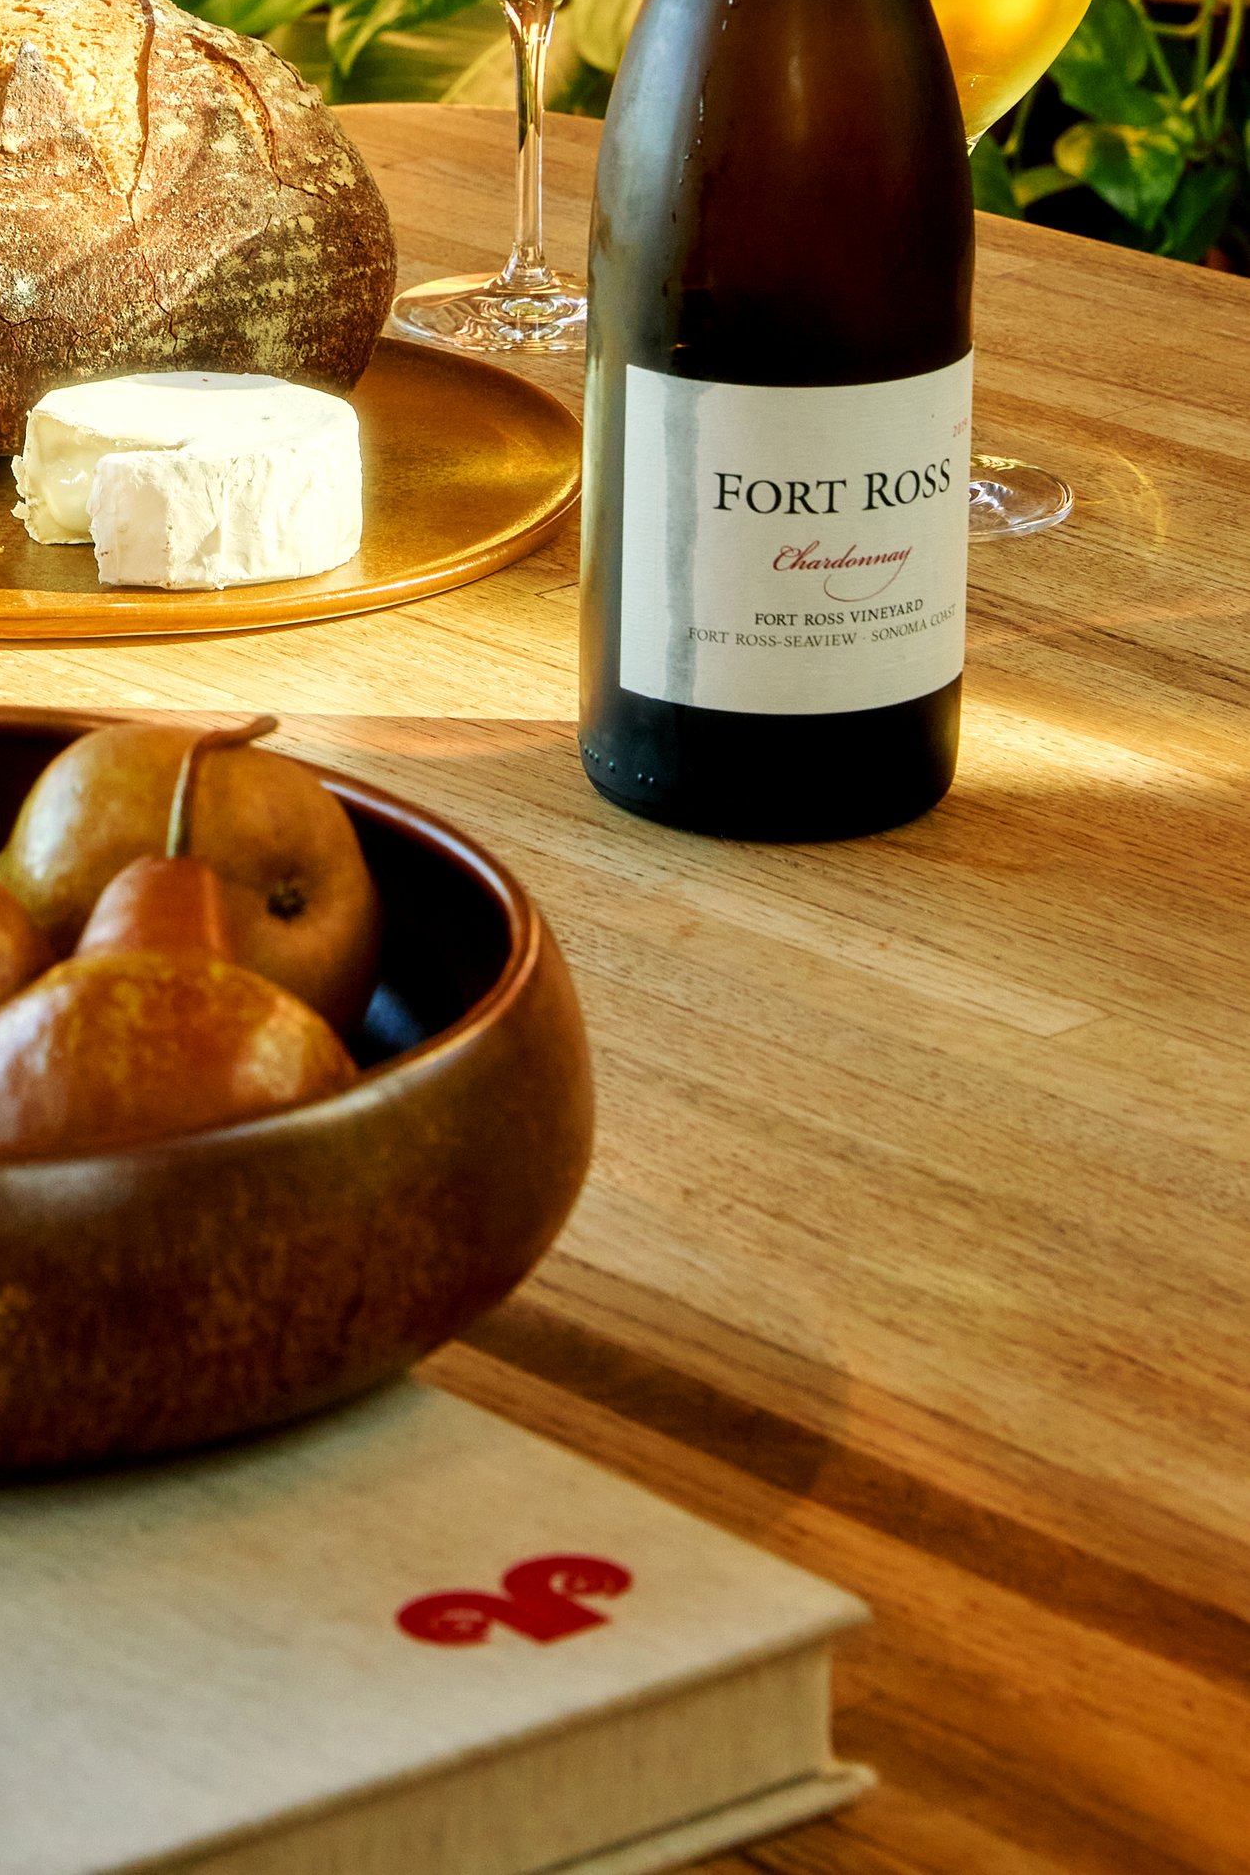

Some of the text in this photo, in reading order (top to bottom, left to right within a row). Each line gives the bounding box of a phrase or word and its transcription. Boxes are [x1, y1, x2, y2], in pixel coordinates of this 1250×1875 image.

[713, 458, 951, 515] FORT ROSS
[772, 540, 913, 602] Chardonnay
[688, 603, 957, 648] FORT ROSS-SEAVIEW SONOMA COAST
[754, 598, 924, 626] FORT ROSS VINEYARD
